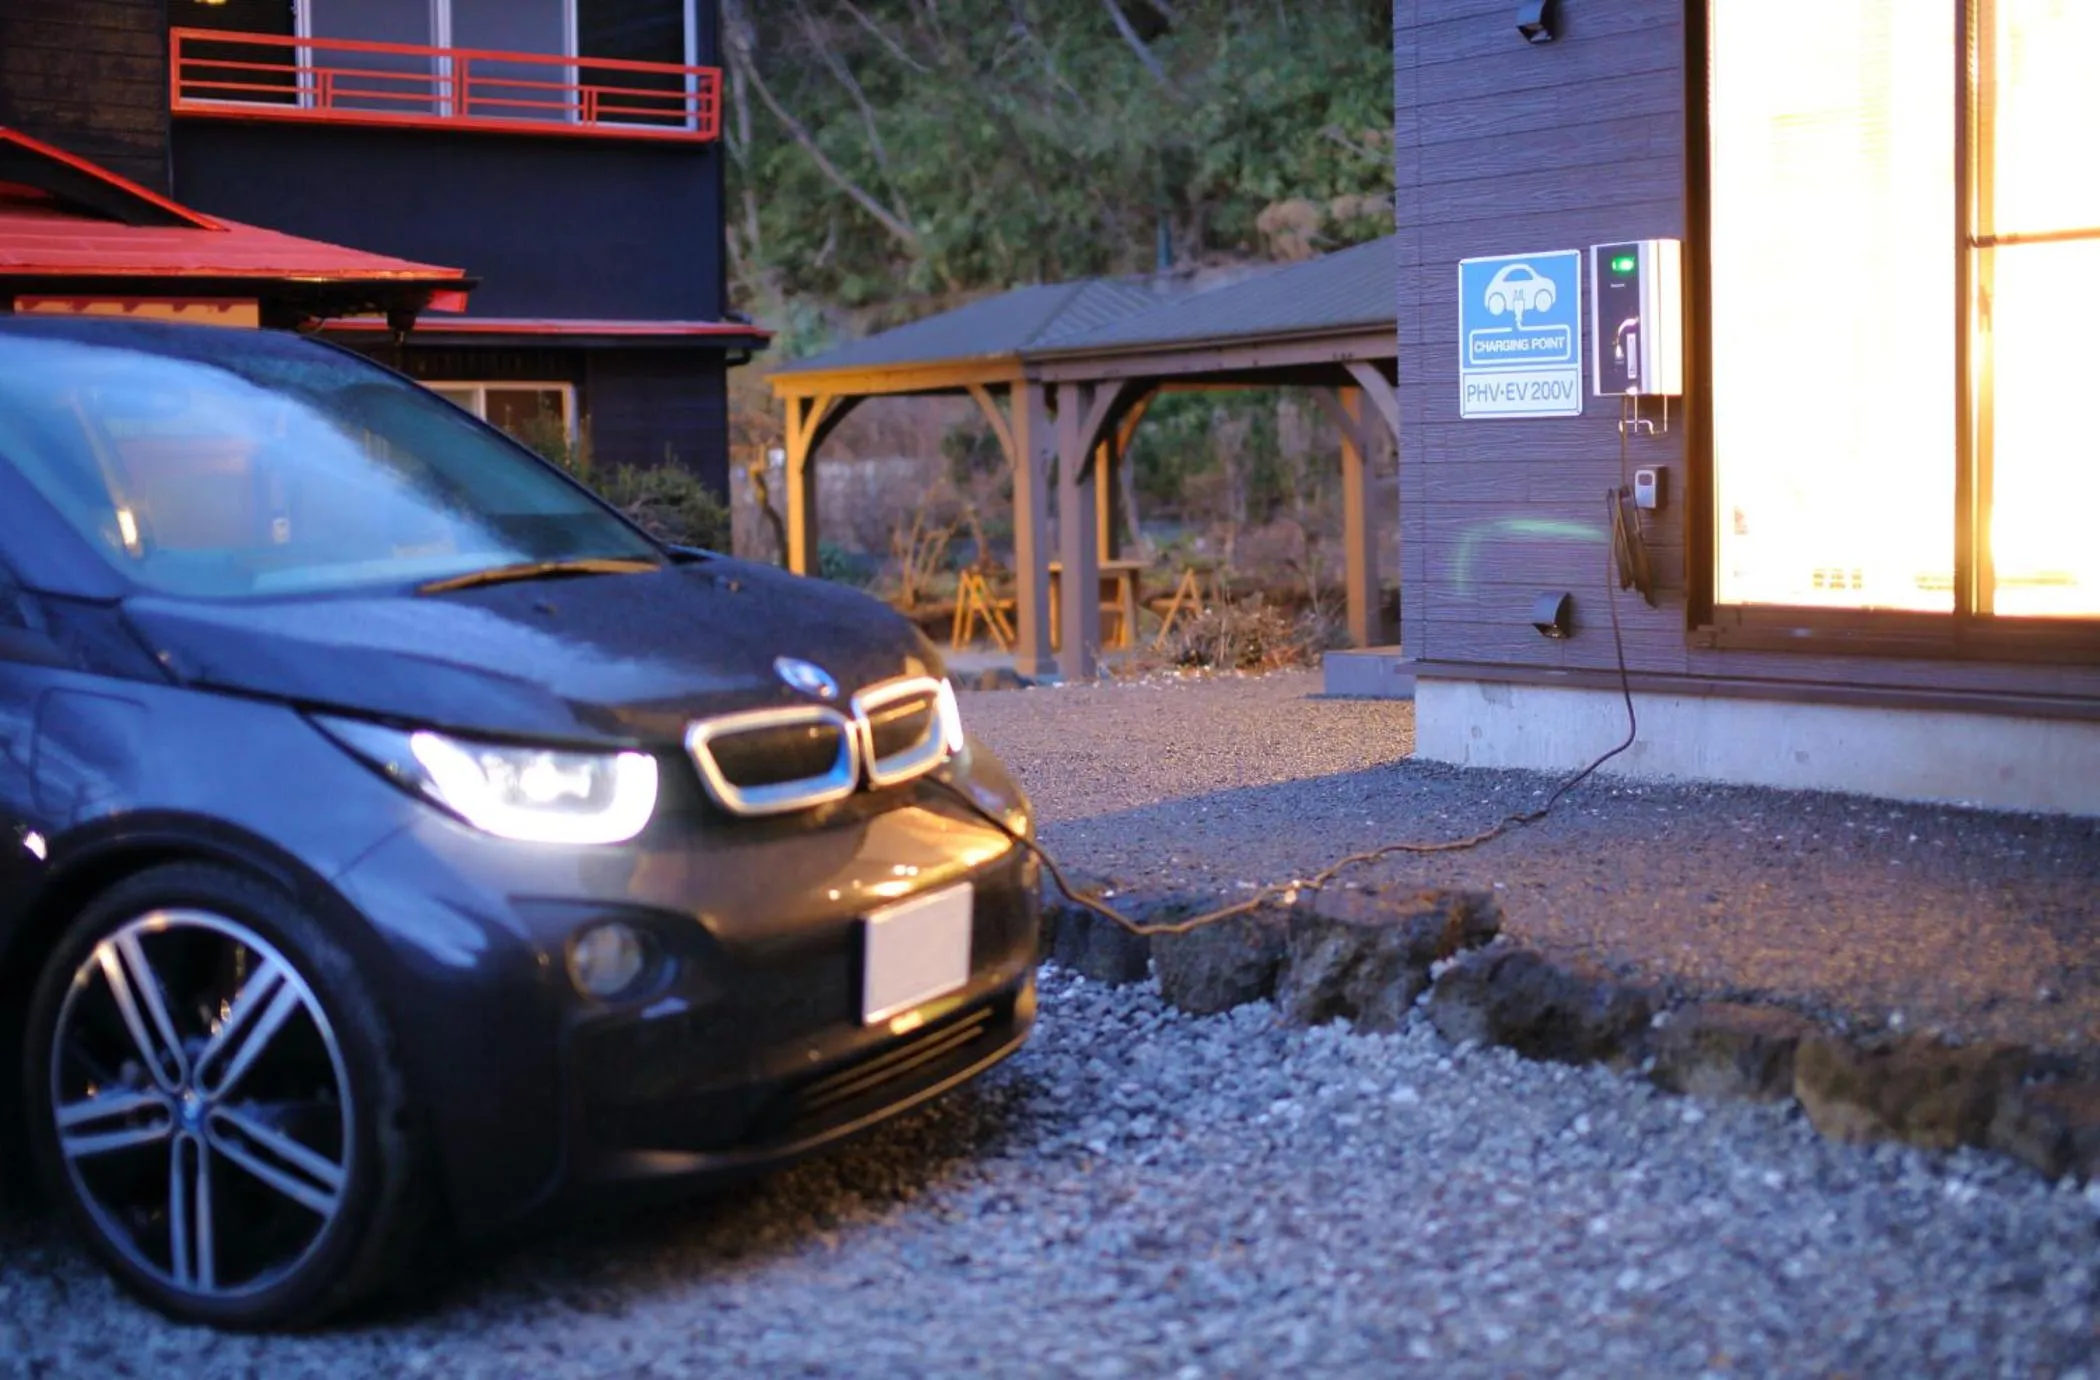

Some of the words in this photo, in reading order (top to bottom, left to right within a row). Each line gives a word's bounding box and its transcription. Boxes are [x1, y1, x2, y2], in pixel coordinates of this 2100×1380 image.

[1474, 338, 1529, 353] CHARGING
[1531, 336, 1565, 350] POINT
[1531, 380, 1573, 400] 200V
